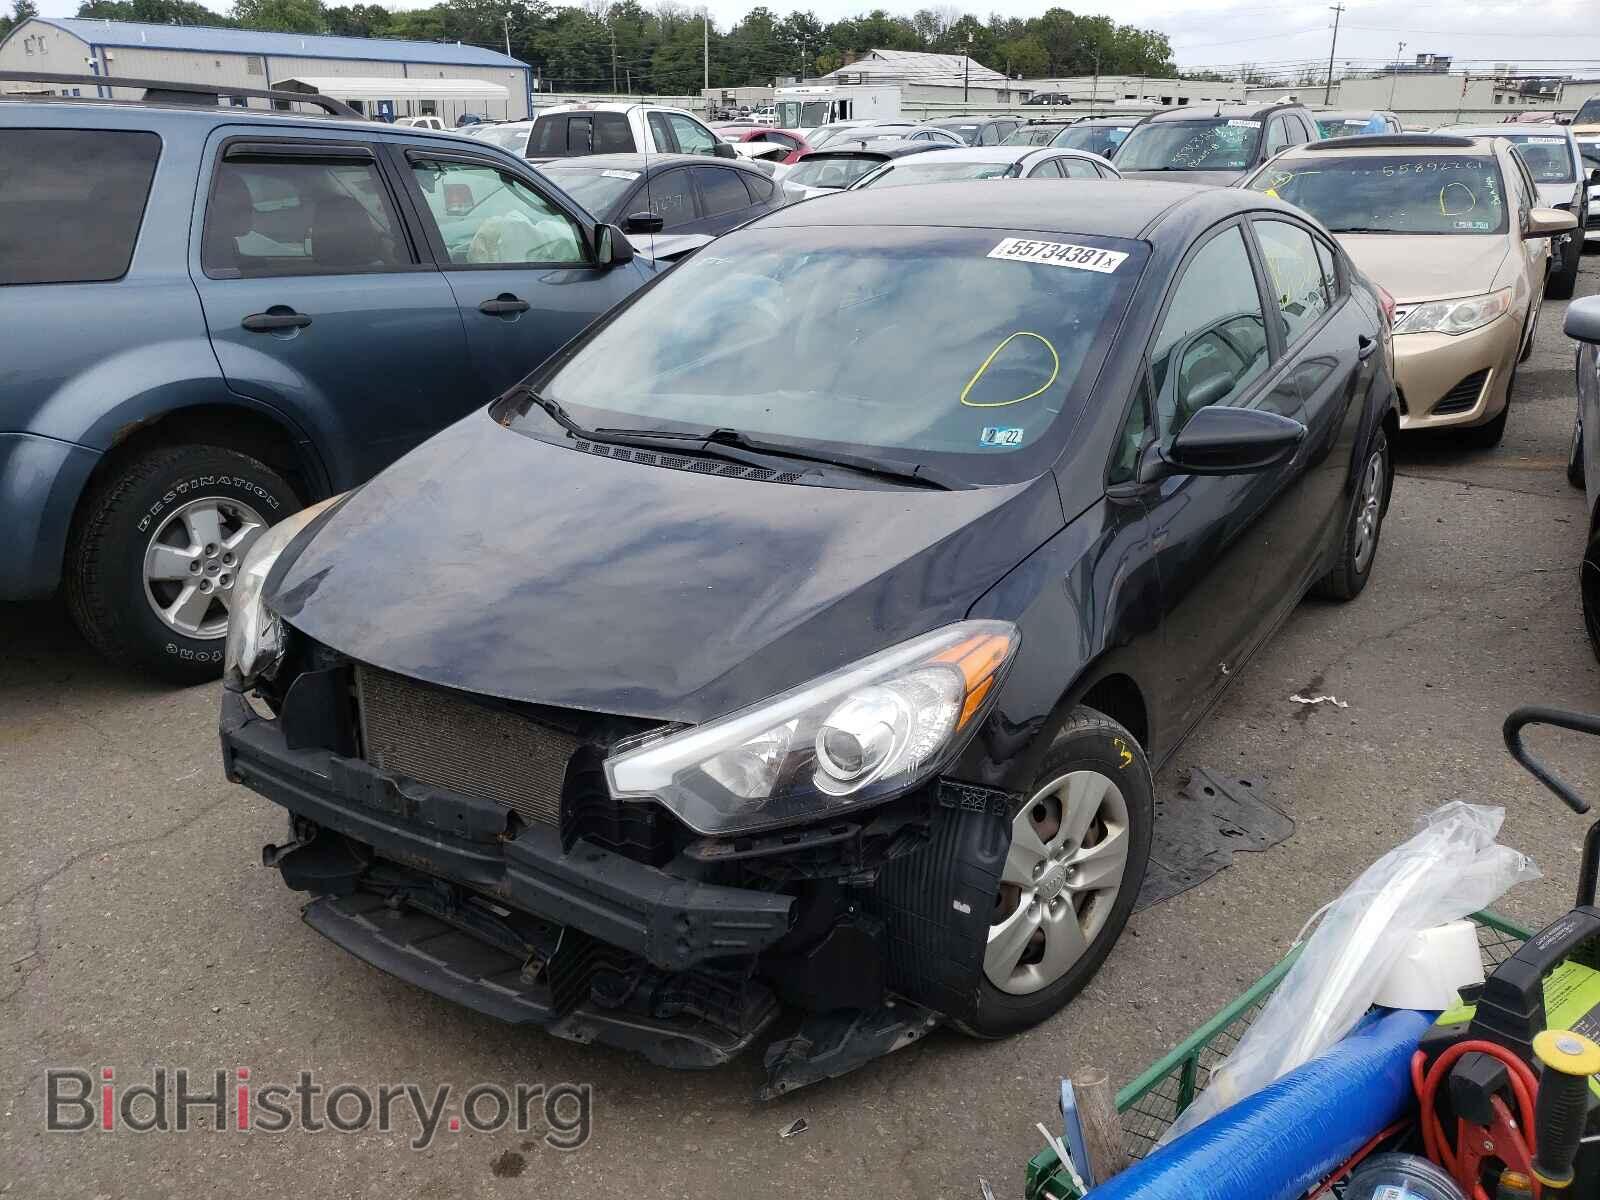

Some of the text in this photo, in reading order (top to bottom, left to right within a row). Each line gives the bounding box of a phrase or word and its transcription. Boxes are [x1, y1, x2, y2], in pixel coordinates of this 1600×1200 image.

[1007, 240, 1107, 266] 55734381
[1005, 430, 1019, 444] 22
[137, 475, 280, 532] DESTINATION
